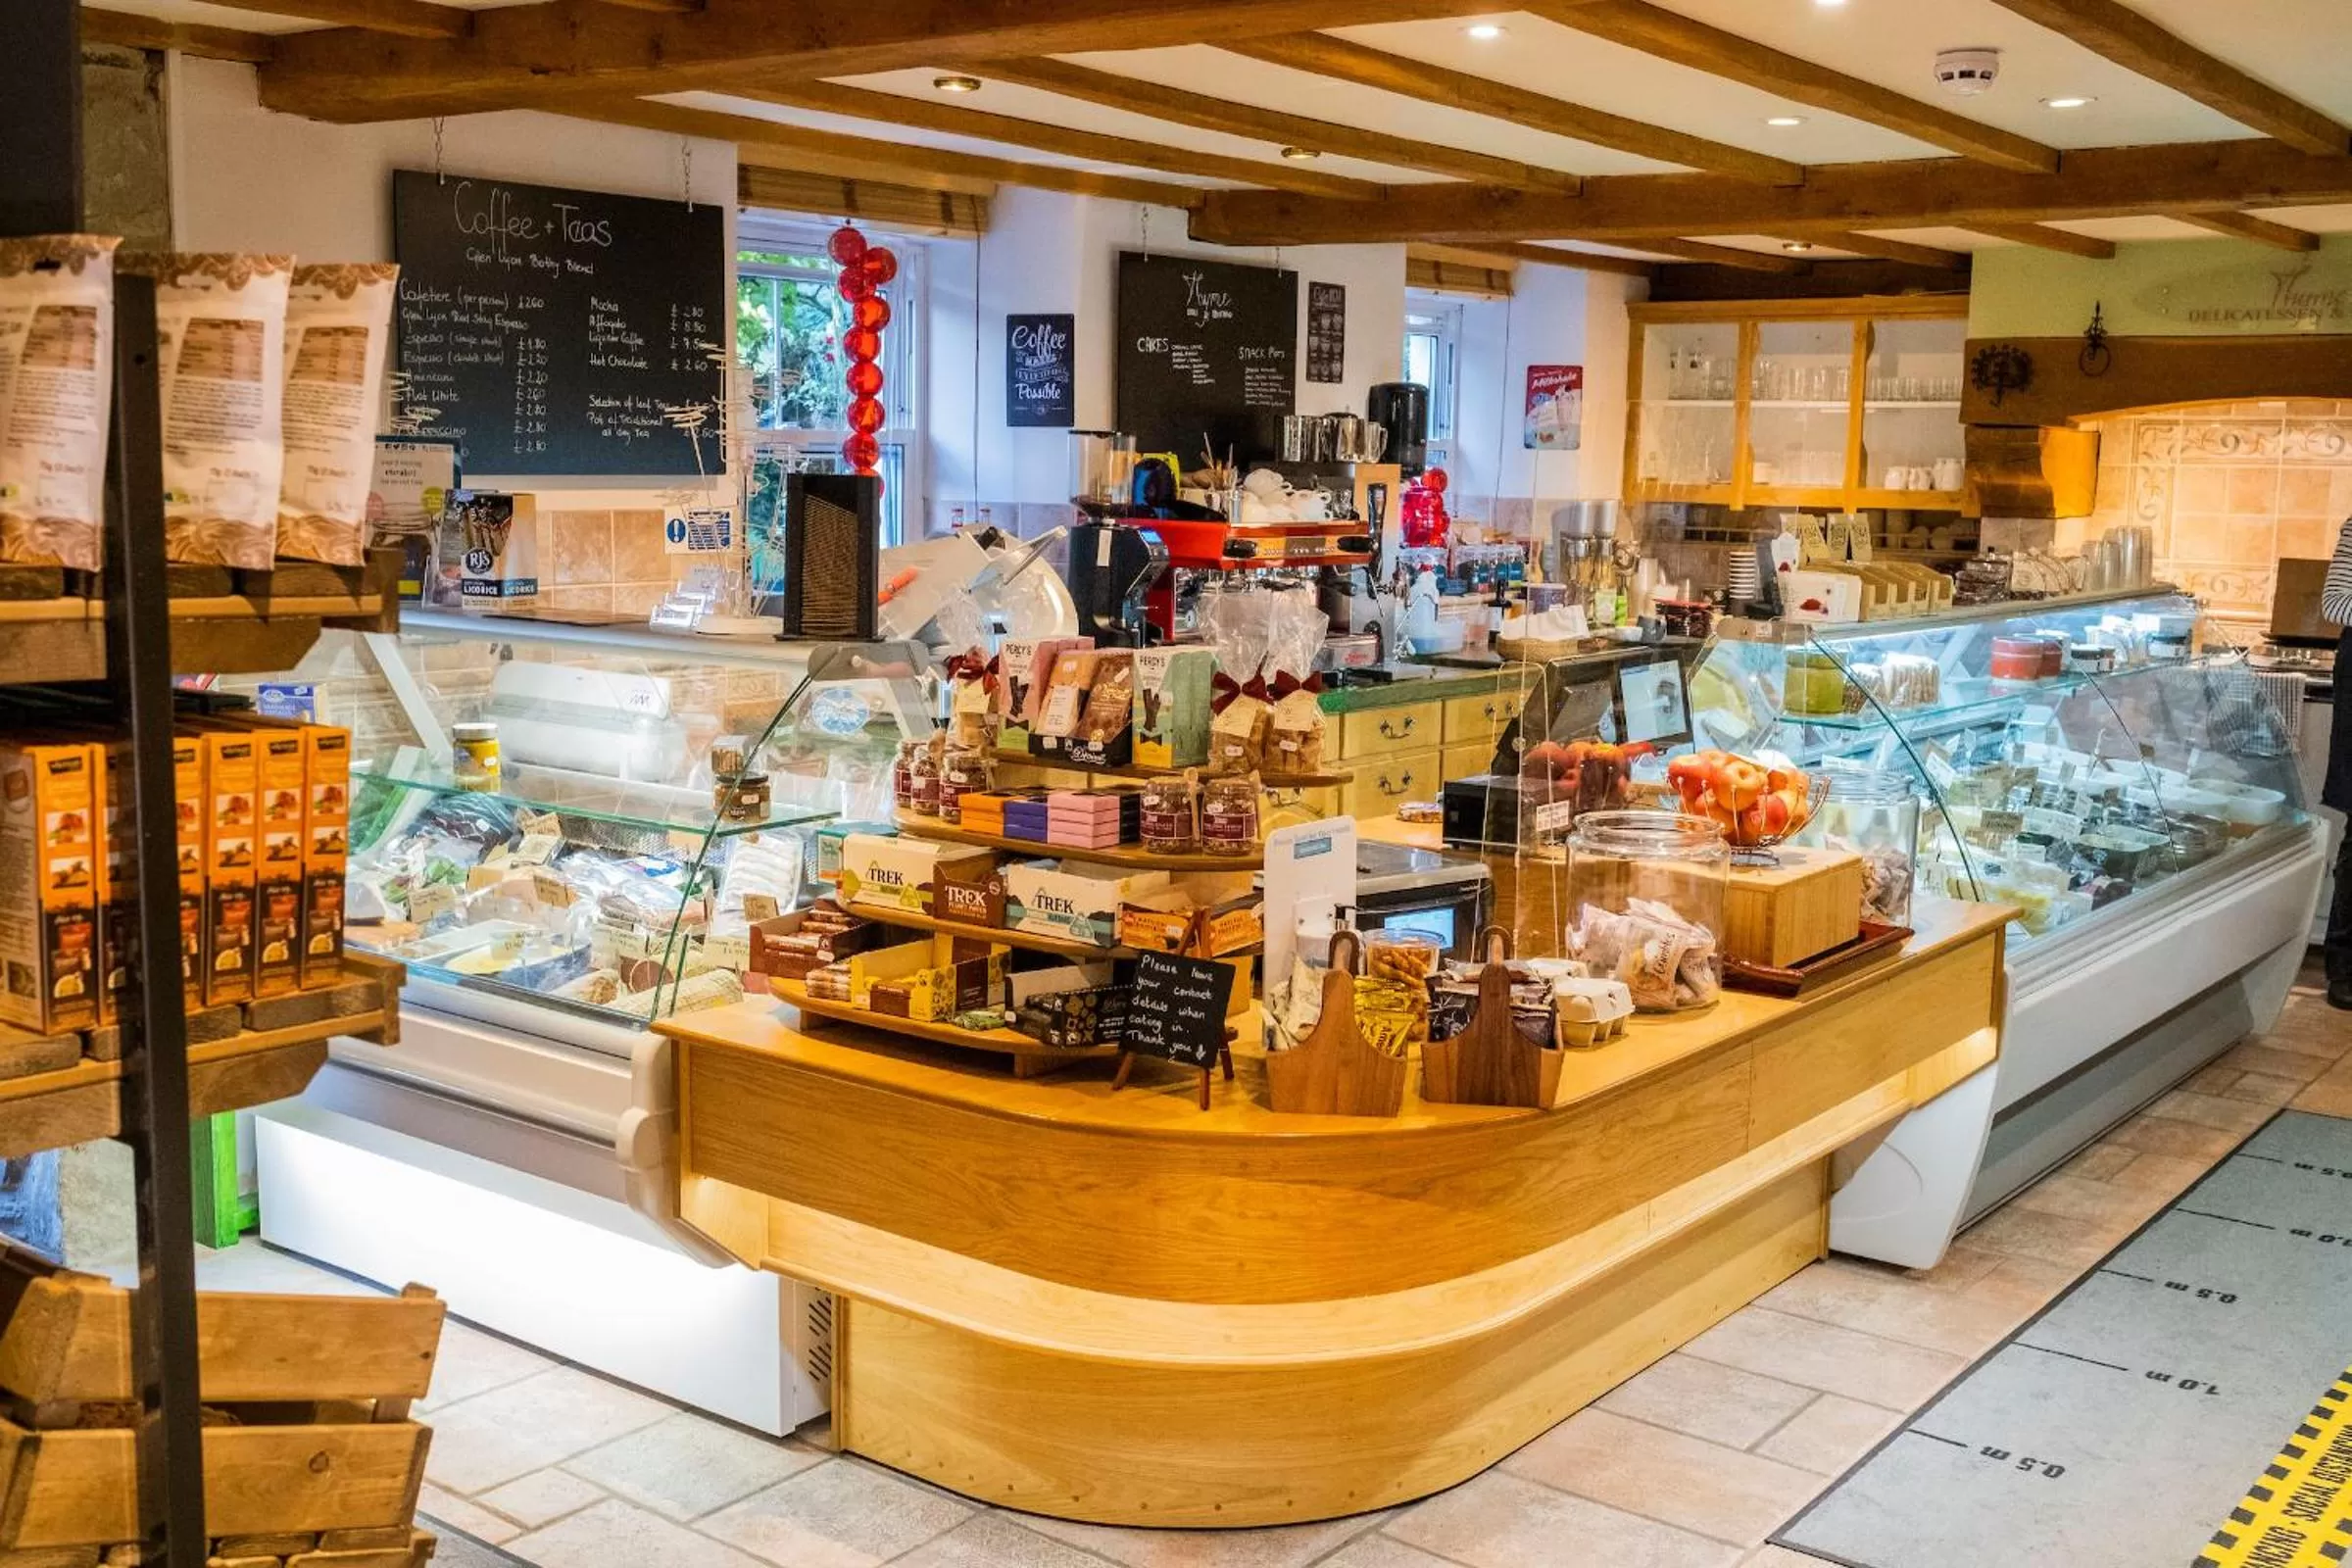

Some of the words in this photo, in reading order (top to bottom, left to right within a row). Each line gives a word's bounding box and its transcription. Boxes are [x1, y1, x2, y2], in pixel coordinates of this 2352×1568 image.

[454, 180, 540, 255] Coffee
[1011, 323, 1067, 359] Coffee
[1137, 337, 1169, 353] CAKES
[1015, 382, 1061, 400] Possible
[464, 585, 498, 595] LICORICE
[868, 867, 904, 887] TREK
[945, 885, 987, 907] TREK
[1035, 894, 1074, 914] TREK
[1141, 955, 1178, 974] Please
[1192, 967, 1214, 982] have
[1137, 976, 1160, 990] your
[1173, 987, 1212, 1000] contact
[1132, 996, 1168, 1012] details
[1178, 1006, 1205, 1019] when
[1126, 1030, 1166, 1046] Thank
[1168, 1042, 1193, 1062] you
[2164, 1280, 2189, 1292] m
[2195, 1288, 2238, 1304] 0.5
[2144, 1370, 2174, 1383] m
[2177, 1379, 2221, 1396] 1.0
[1980, 1446, 2012, 1461] m
[2015, 1457, 2066, 1479] 0.5
[2280, 1481, 2342, 1523] SOCIAL
